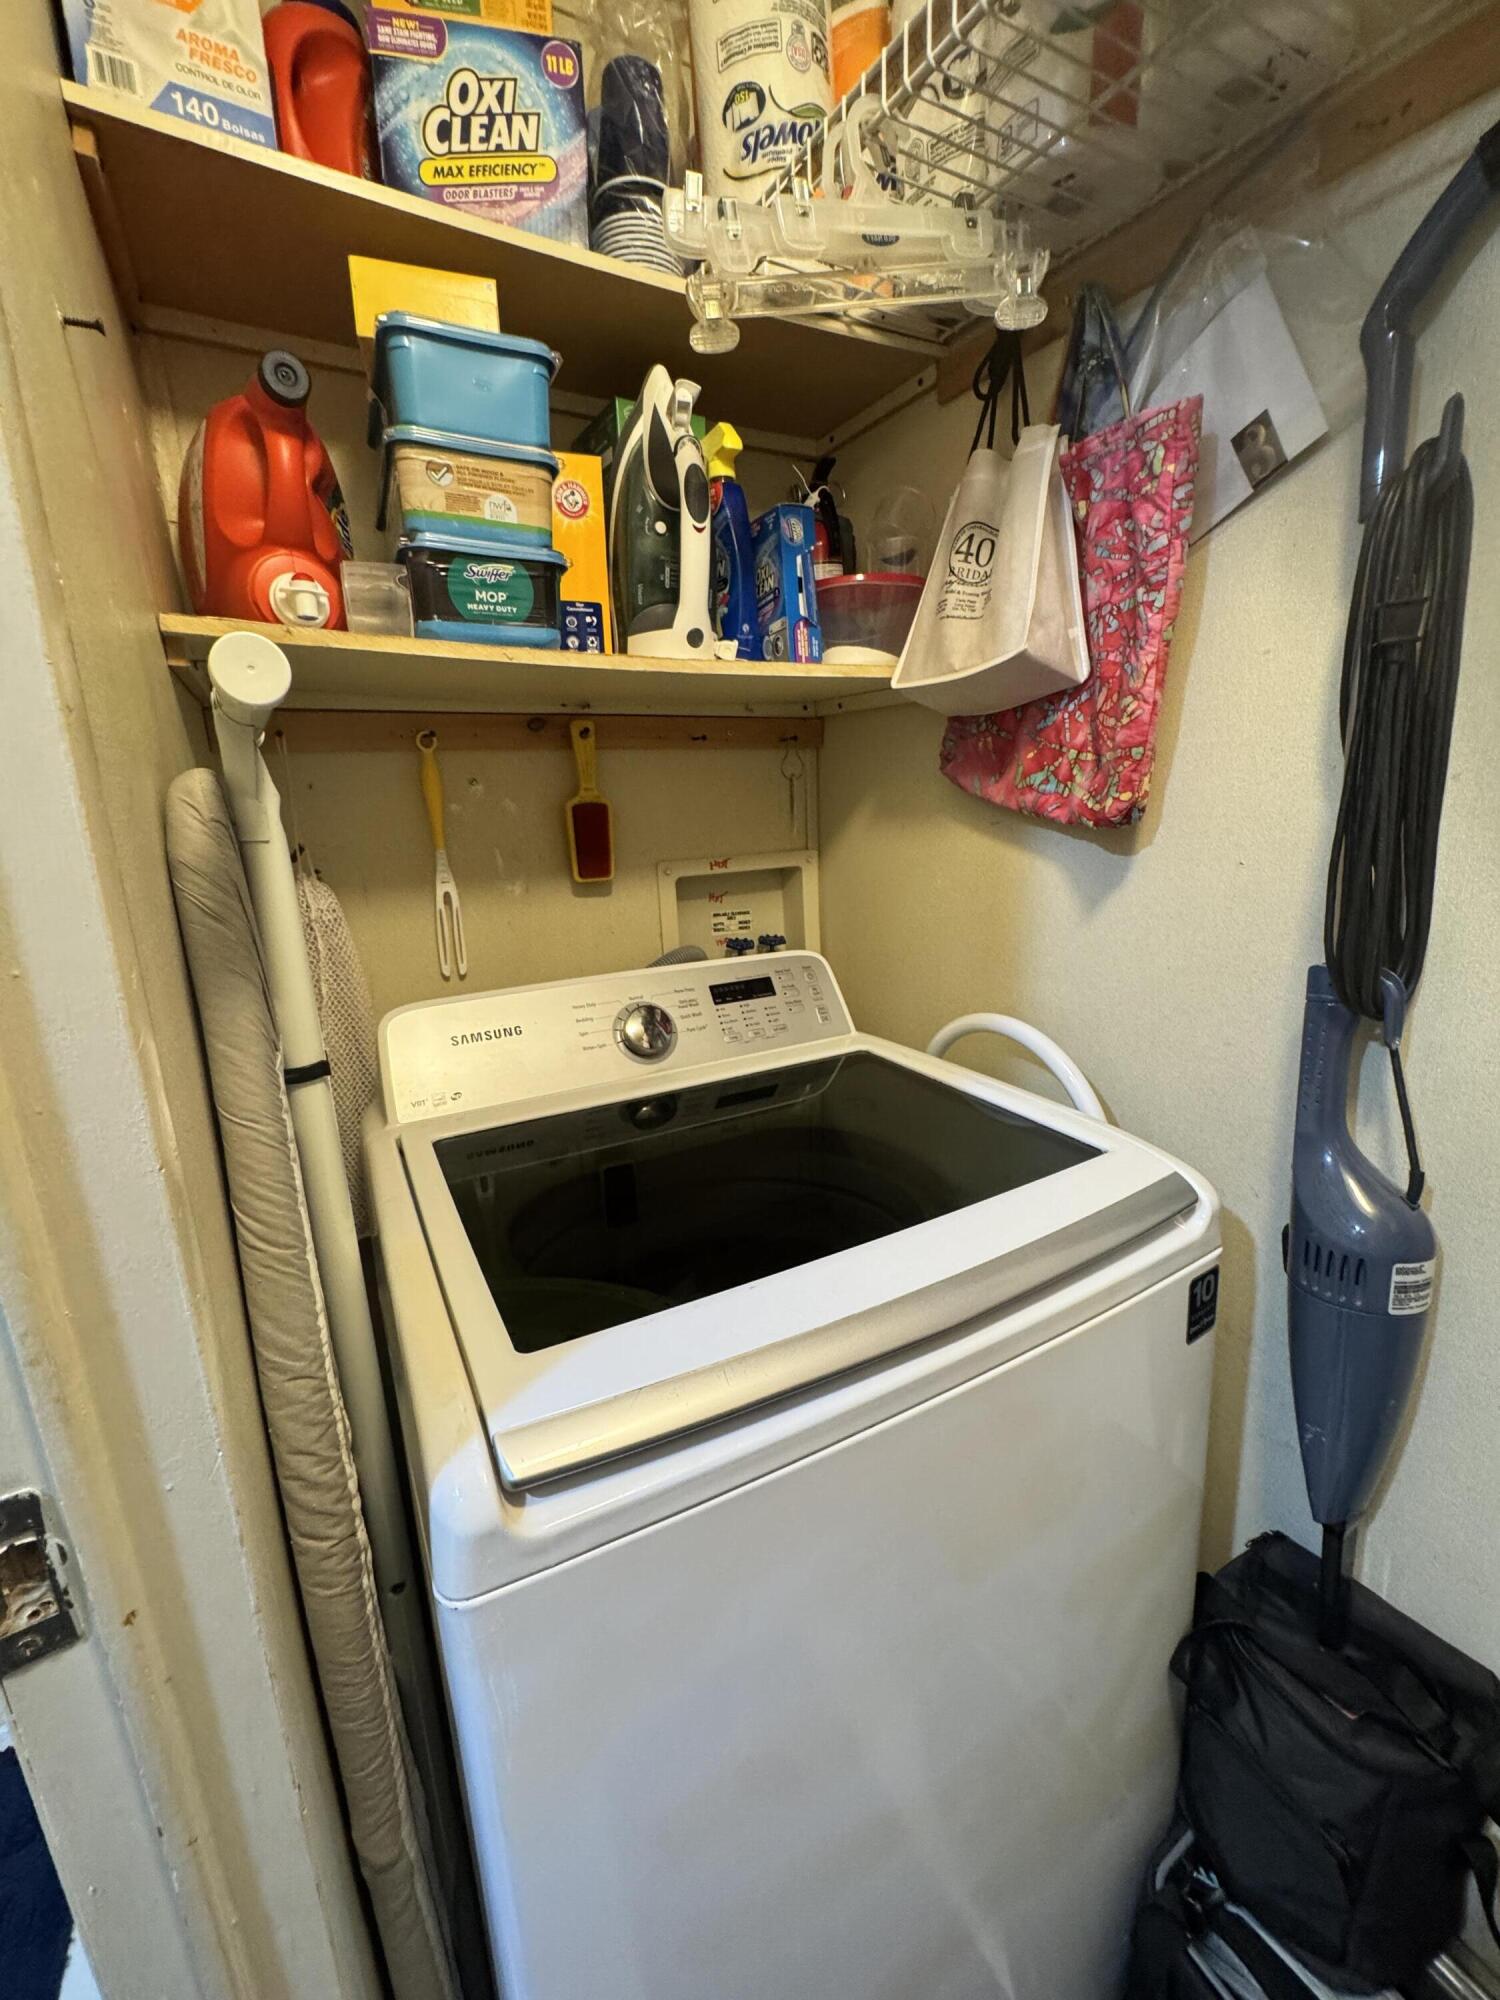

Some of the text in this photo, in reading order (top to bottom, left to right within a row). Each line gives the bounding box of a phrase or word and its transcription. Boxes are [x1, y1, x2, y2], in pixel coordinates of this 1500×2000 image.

[392, 17, 420, 31] NEW!
[175, 28, 240, 62] AROMA
[188, 47, 257, 84] FRESCO
[546, 54, 574, 76] 11 LB
[175, 63, 261, 101] CONTROL DE OLOR
[446, 67, 517, 117] OXI
[169, 90, 266, 143] 140 Bolsas
[423, 105, 541, 157] CLEAN
[433, 165, 464, 178] MAX
[445, 188, 470, 201] ODOR
[472, 187, 515, 200] BLASTERS
[954, 532, 996, 568] 40
[464, 564, 513, 583] Swiffer
[467, 603, 494, 612] HEAVY
[496, 605, 517, 614] DUTY
[475, 589, 507, 603] MOP
[451, 1025, 523, 1047] SAMSUNG
[1192, 1274, 1216, 1308] 10
